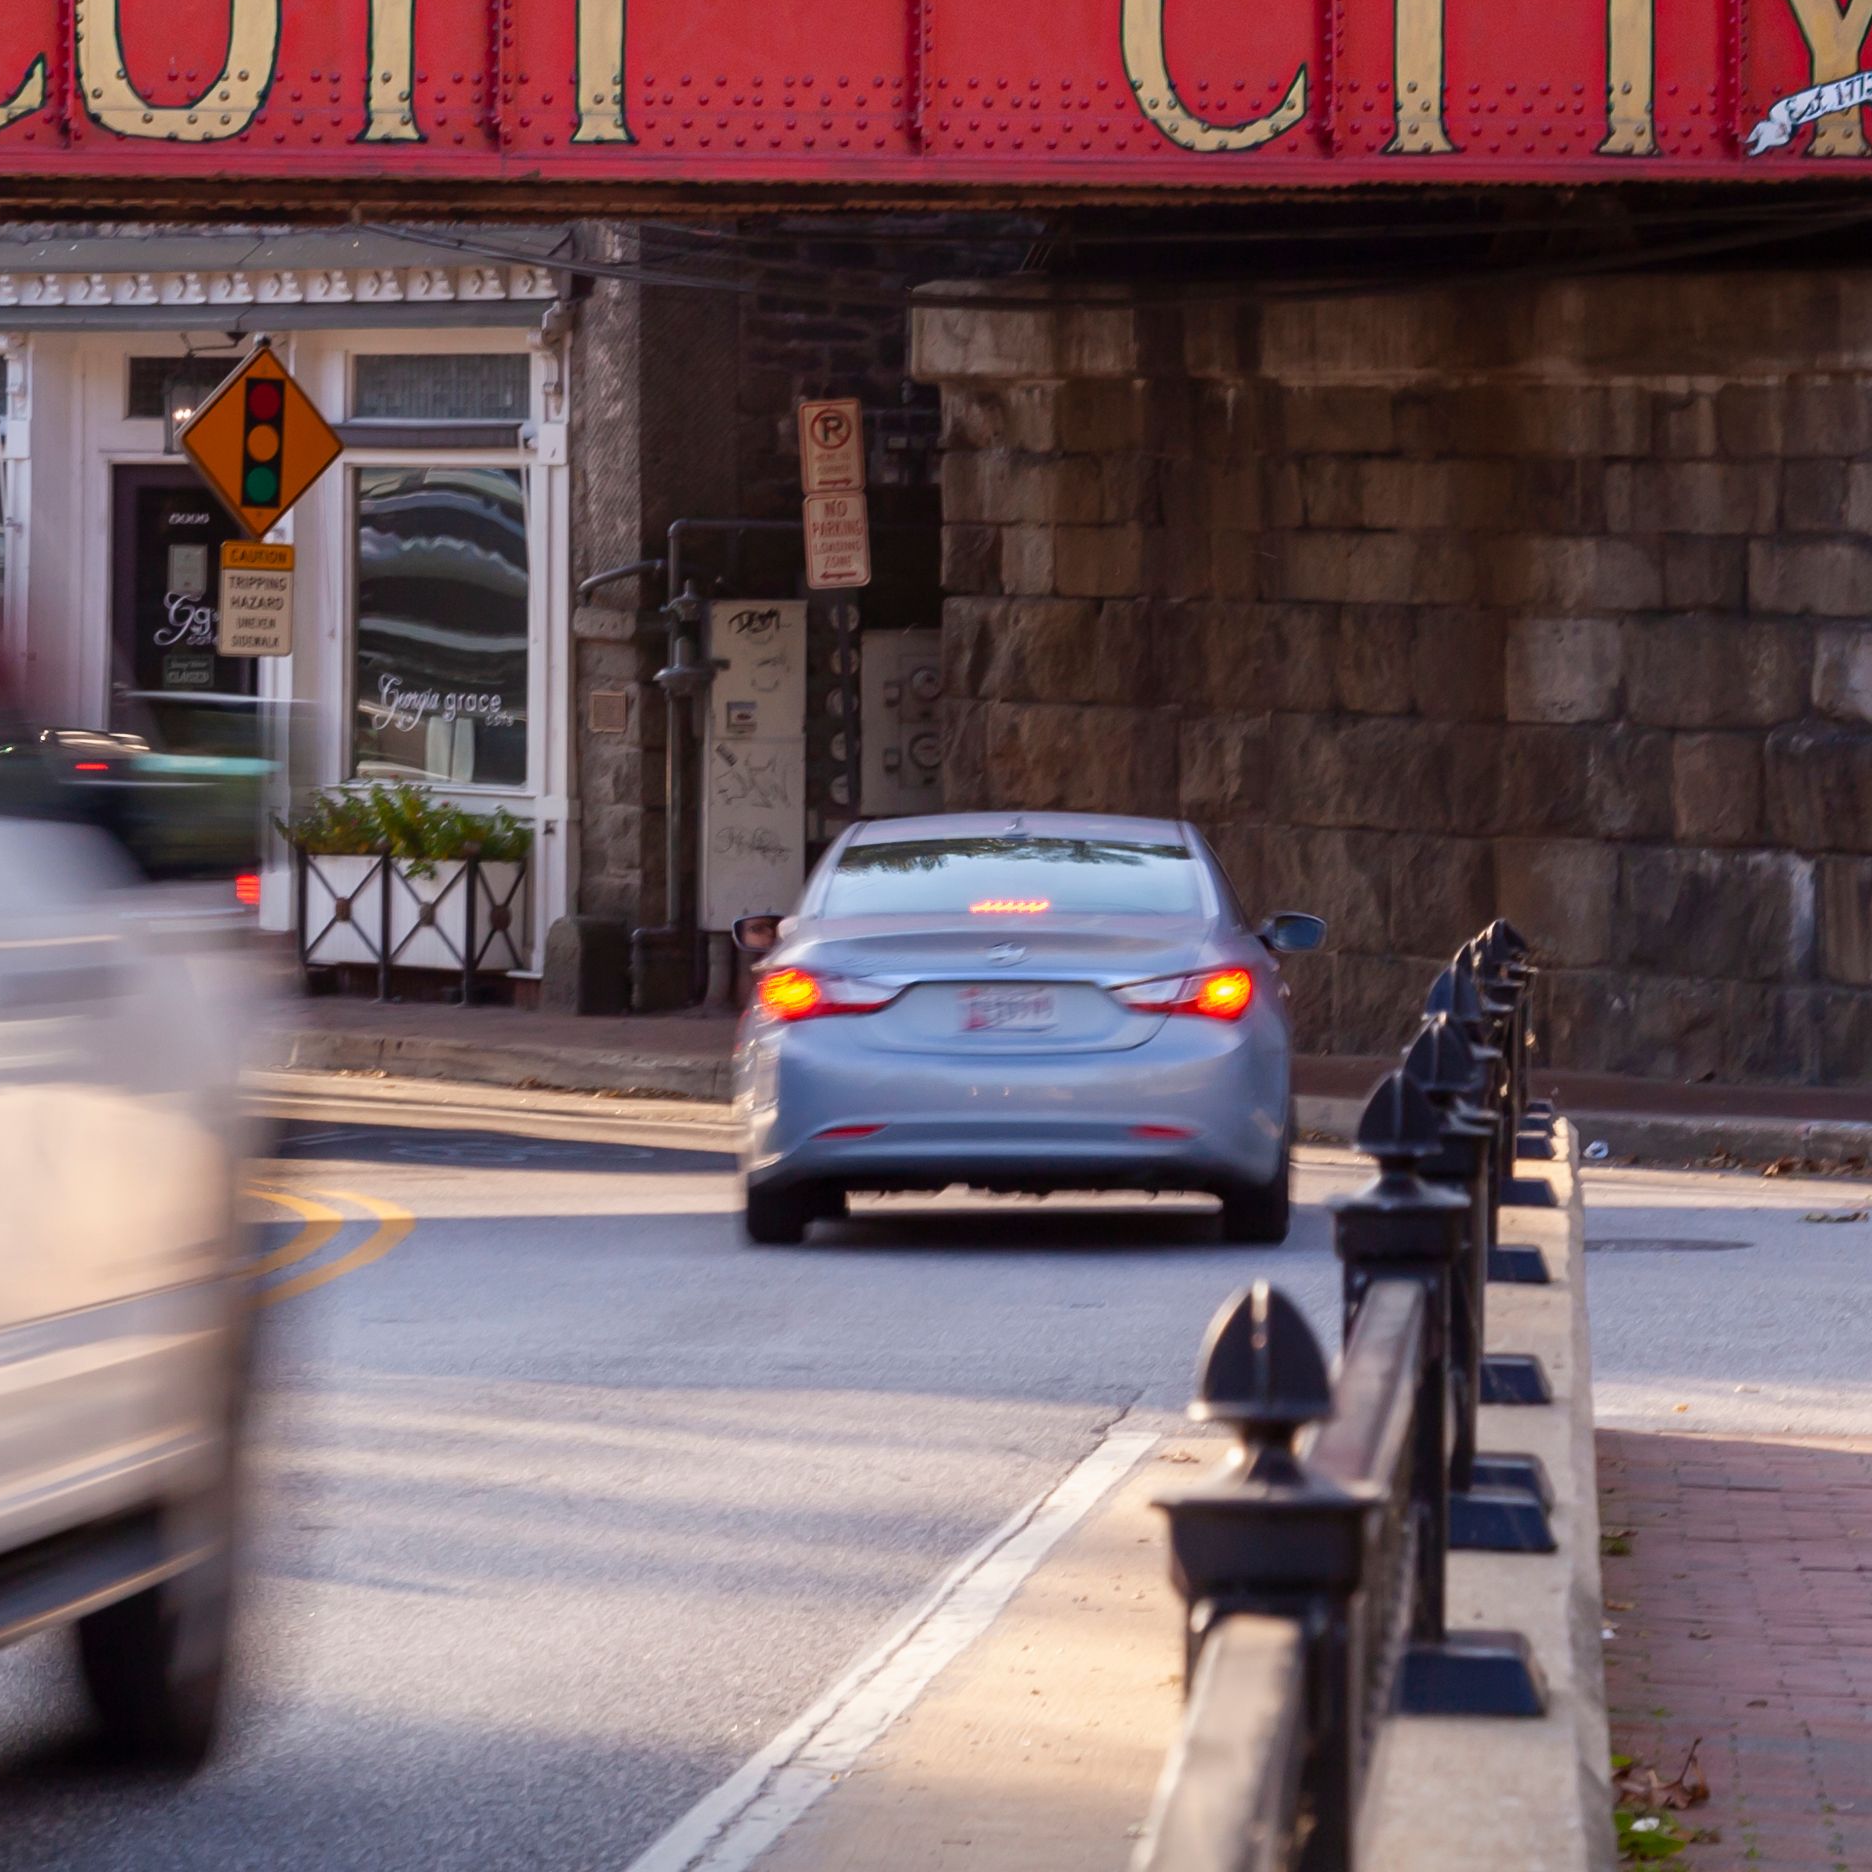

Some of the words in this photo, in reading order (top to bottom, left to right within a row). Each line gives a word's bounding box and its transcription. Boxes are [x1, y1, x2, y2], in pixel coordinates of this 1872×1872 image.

[823, 499, 849, 518] NO
[812, 519, 863, 538] PARKING
[231, 548, 287, 563] CAUTION
[230, 576, 288, 592] TRIPPING
[231, 596, 285, 611] HAZARD
[442, 692, 503, 722] grace
